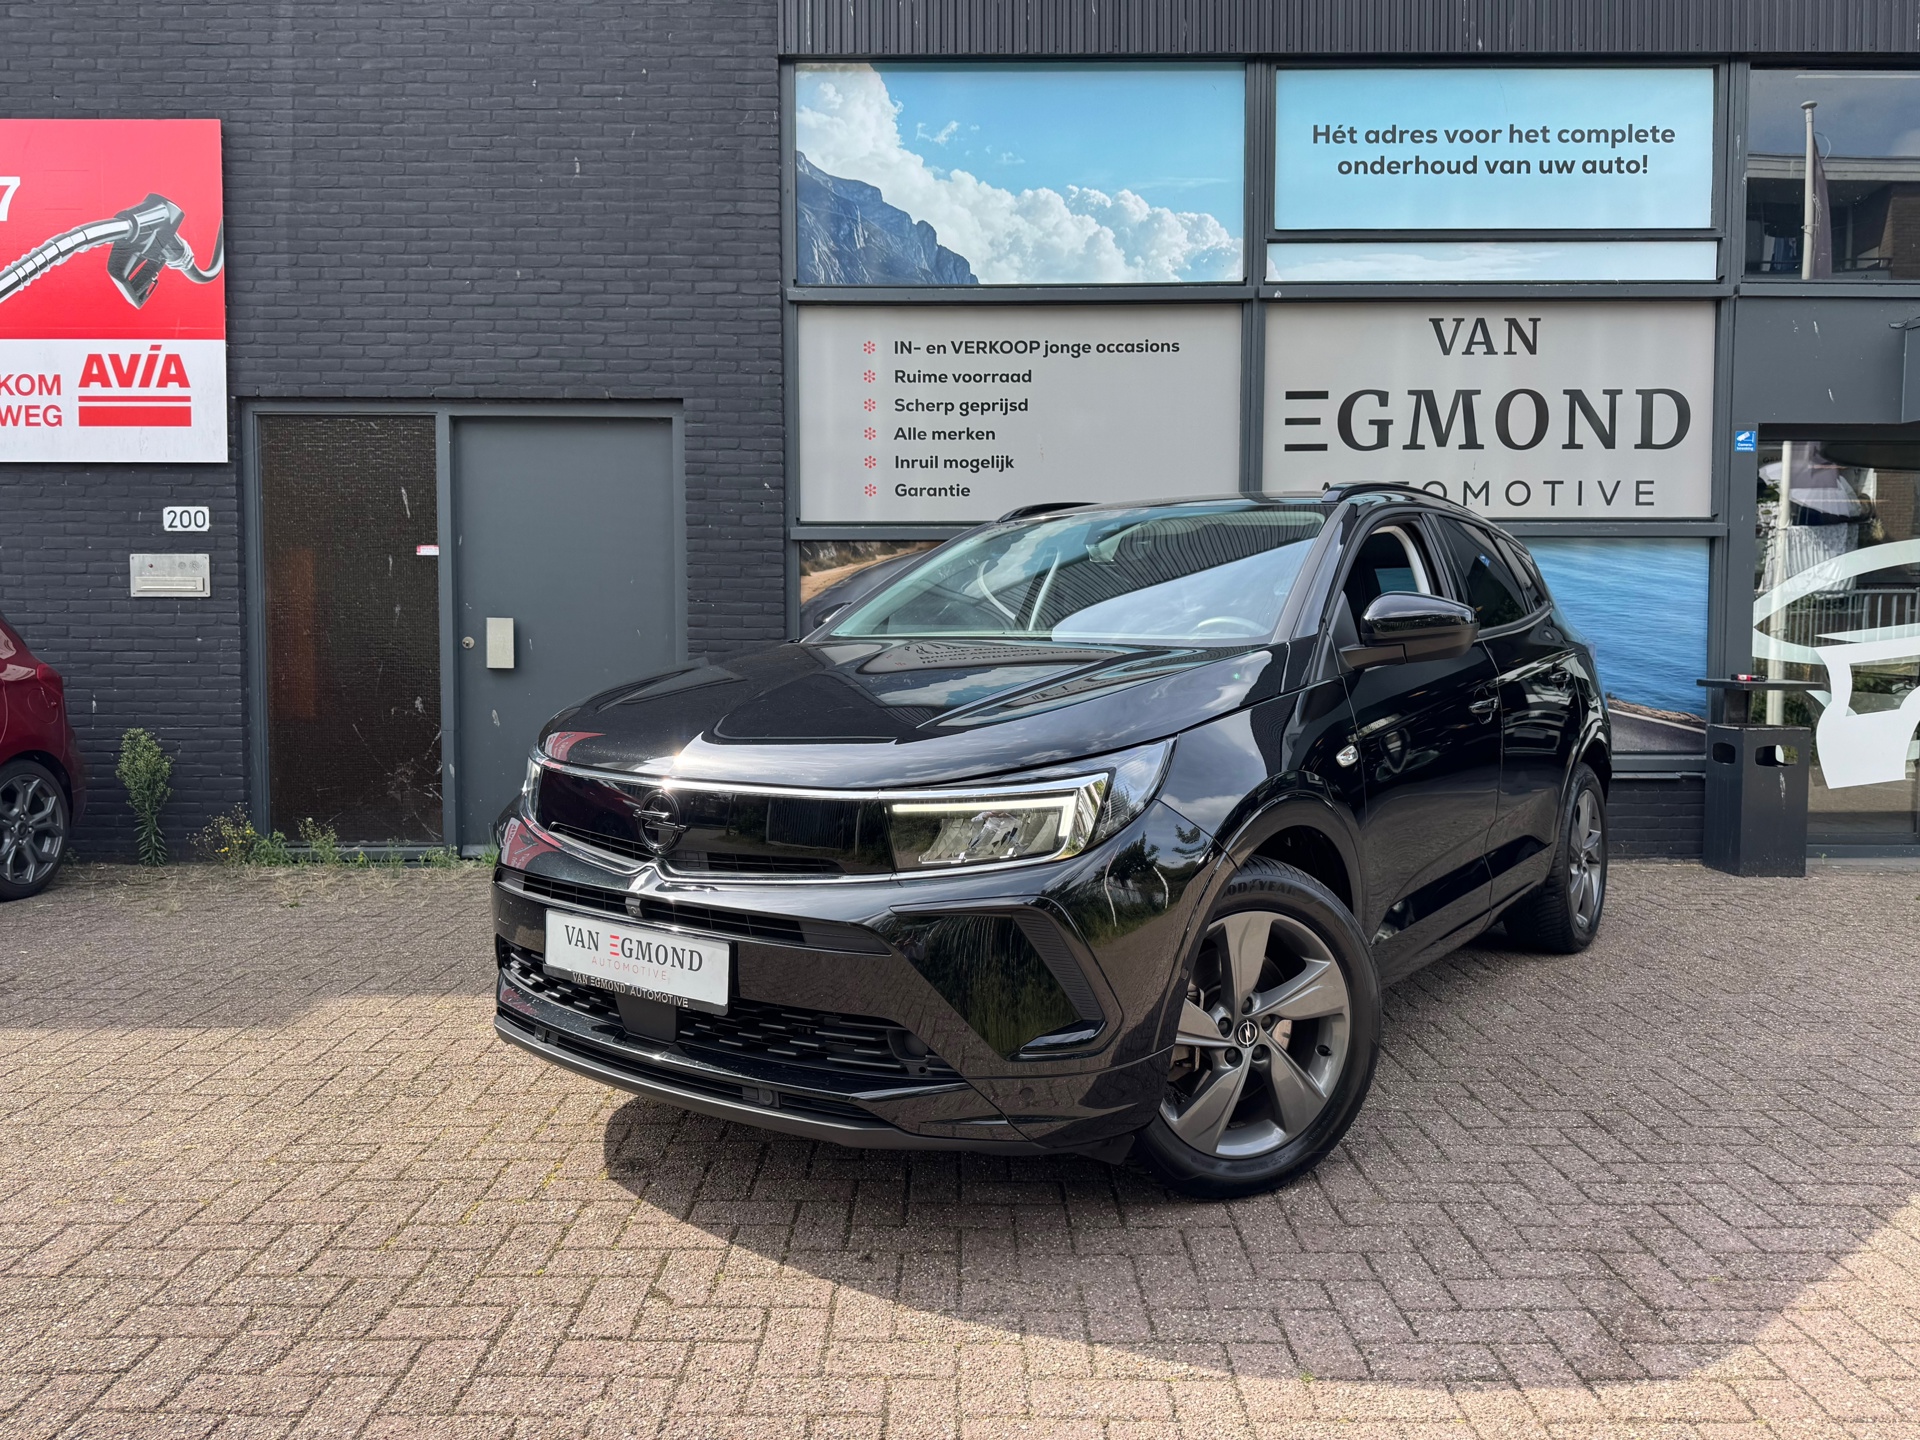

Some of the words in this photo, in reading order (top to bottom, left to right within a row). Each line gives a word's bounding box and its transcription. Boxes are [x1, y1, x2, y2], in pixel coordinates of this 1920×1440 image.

[1312, 124, 1357, 145] Hét
[1364, 124, 1438, 144] adres
[1443, 129, 1503, 144] voor
[1509, 124, 1551, 144] het
[1557, 123, 1676, 149] complete
[1337, 155, 1478, 175] onderhoud
[1484, 159, 1531, 175] van
[1538, 159, 1576, 175] uw
[1581, 155, 1648, 175] auto!
[1429, 317, 1542, 356] VAN
[894, 340, 922, 355] IN-
[925, 344, 947, 355] en
[950, 340, 1041, 355] VERKOOP
[1042, 340, 1092, 359] jonge
[1095, 339, 1180, 354] occasions
[894, 369, 949, 384] Ruime
[951, 369, 1032, 384] voorraad
[0, 404, 63, 428] WEG
[894, 398, 955, 416] Scherp
[959, 397, 1029, 417] geprijsd
[1284, 388, 1691, 452] EGMOND
[893, 426, 928, 441] Alle
[931, 426, 996, 441] merken
[895, 455, 939, 469] Inruil
[943, 454, 1015, 474] mogelijk
[894, 483, 971, 497] Garantie
[1321, 480, 1655, 507] OMOTIVE
[167, 510, 206, 528] 200
[564, 925, 600, 952] VAN
[609, 934, 704, 972] EGMOND
[591, 956, 668, 981] AUTOMOTIVE
[572, 972, 588, 985] VAN
[590, 976, 626, 994] EGMOND
[630, 986, 689, 1008] AUTOMOTIVE
